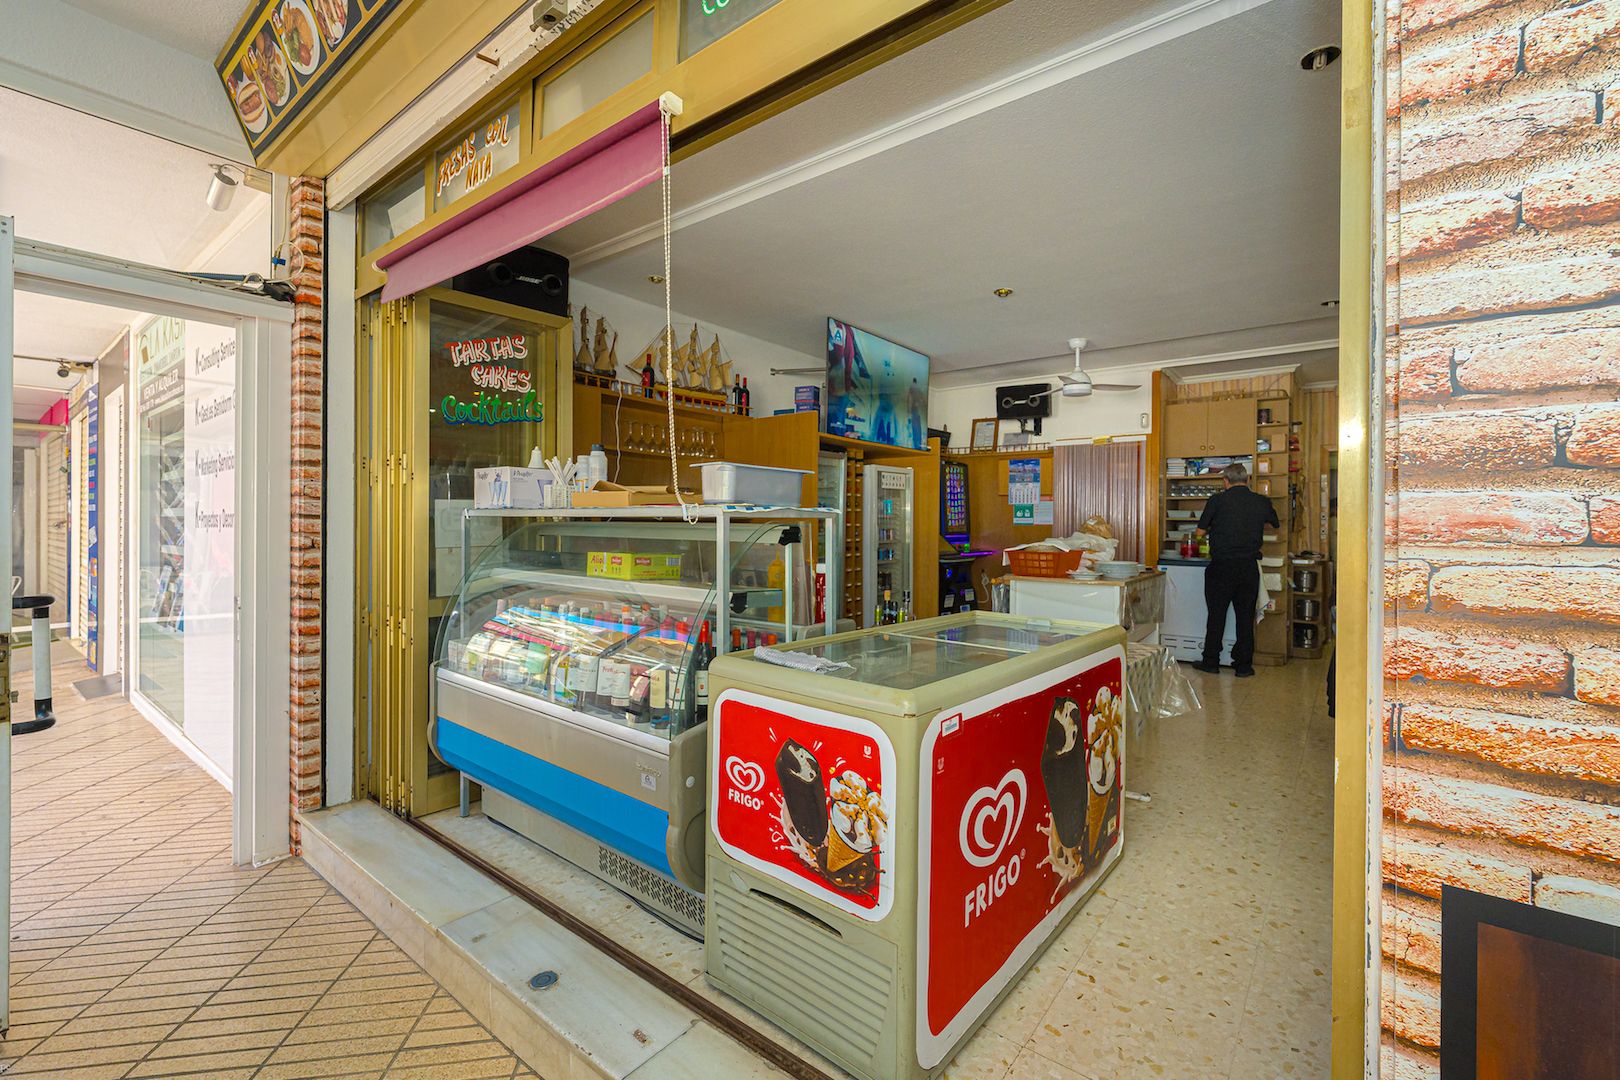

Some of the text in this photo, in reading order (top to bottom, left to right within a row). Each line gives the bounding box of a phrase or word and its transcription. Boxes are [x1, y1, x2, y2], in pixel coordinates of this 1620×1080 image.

[437, 131, 476, 197] FRESAS
[465, 151, 493, 193] NATA
[444, 335, 528, 367] TARTAS
[470, 363, 531, 393] CAKES
[441, 389, 544, 426] Cocktails
[728, 788, 761, 811] FRIGO
[965, 854, 1021, 929] FRIGO
